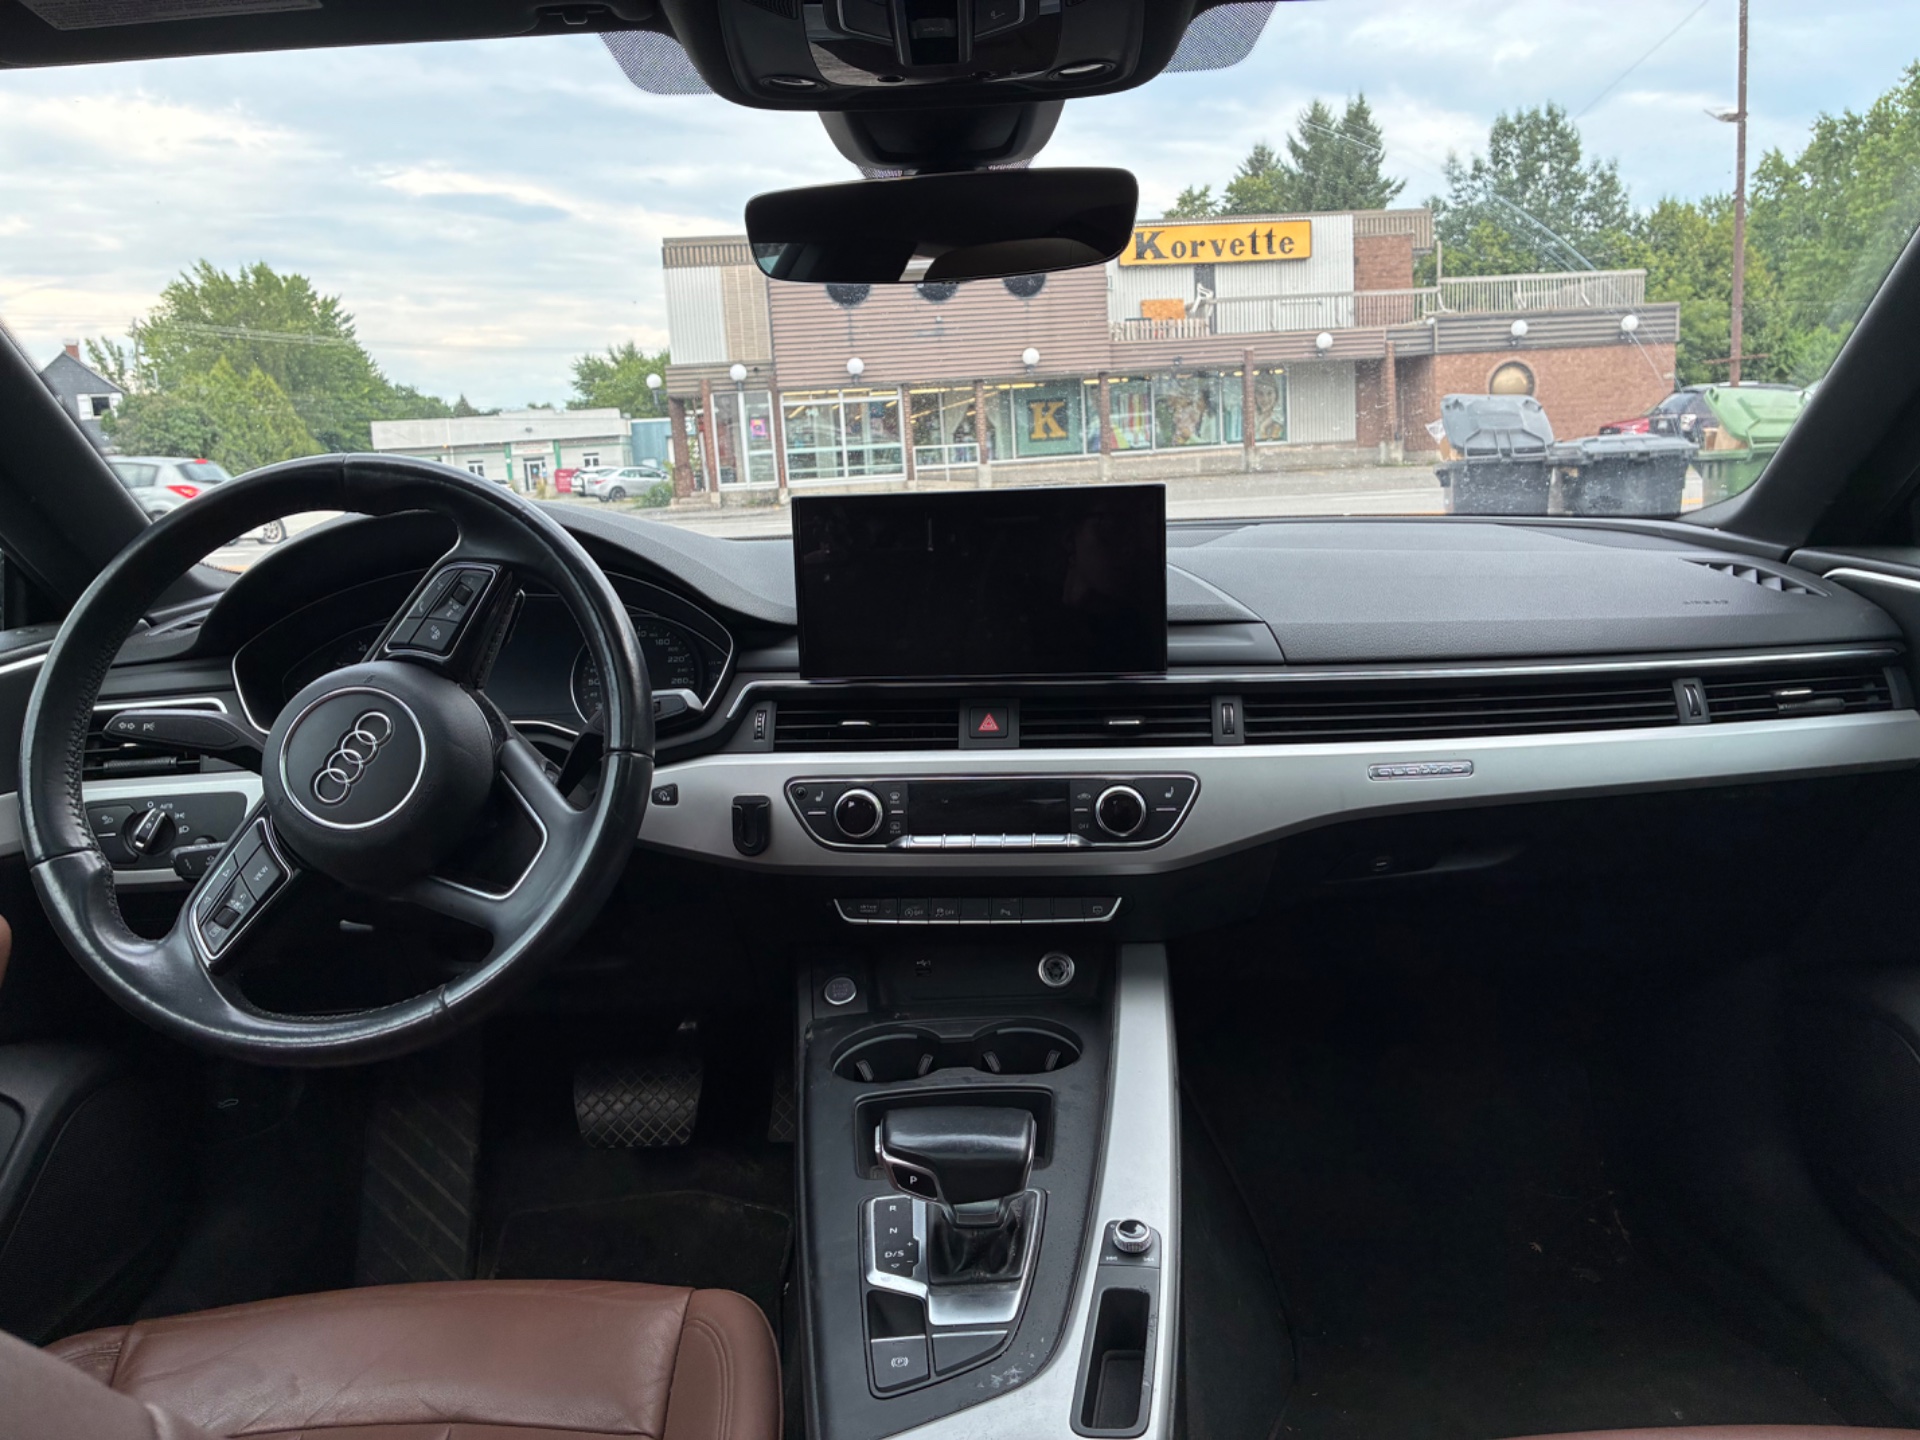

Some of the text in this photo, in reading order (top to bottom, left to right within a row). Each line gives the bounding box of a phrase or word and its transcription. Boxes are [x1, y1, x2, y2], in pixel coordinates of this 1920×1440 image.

[1133, 227, 1294, 261] Korvette
[1029, 401, 1067, 439] K
[1376, 764, 1464, 779] quattro
[253, 865, 269, 881] VIEW
[909, 1175, 918, 1185] P
[884, 1250, 905, 1259] D/S
